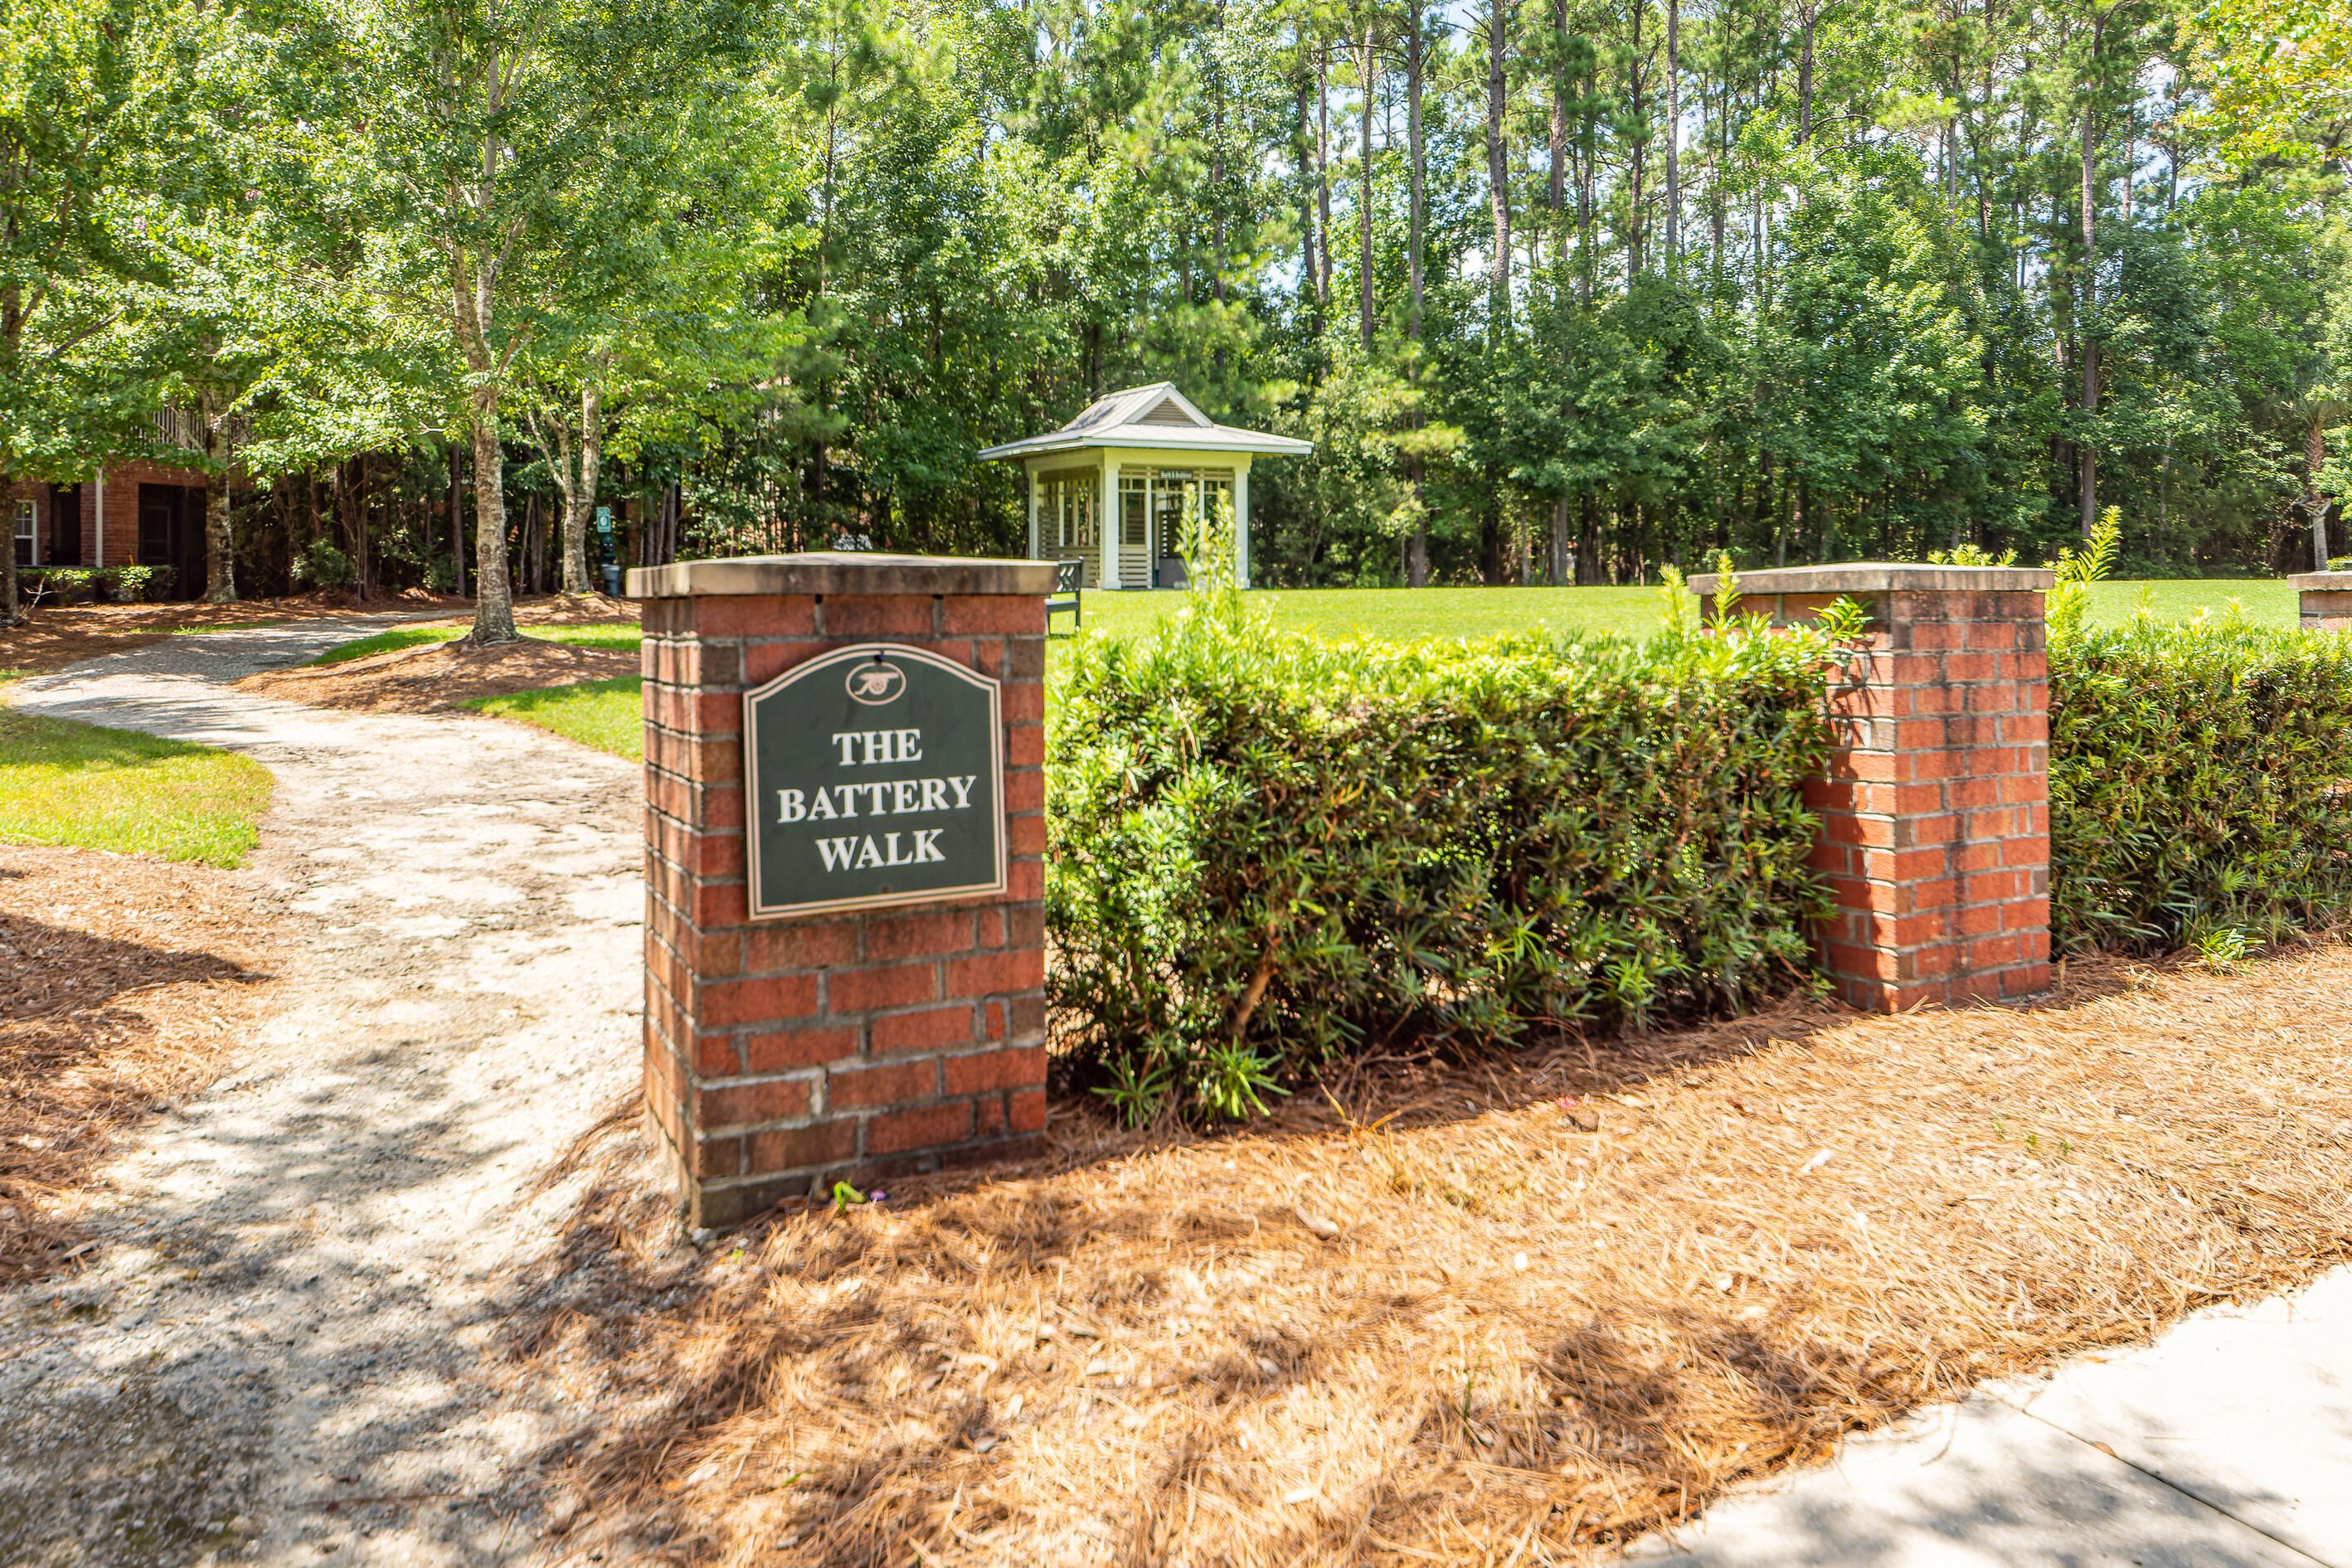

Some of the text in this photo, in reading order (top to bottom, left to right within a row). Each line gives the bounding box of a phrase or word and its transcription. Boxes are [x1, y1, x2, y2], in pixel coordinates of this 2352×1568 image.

[832, 728, 922, 766] THE
[776, 774, 977, 824] BATTERY
[815, 828, 945, 873] WALK
